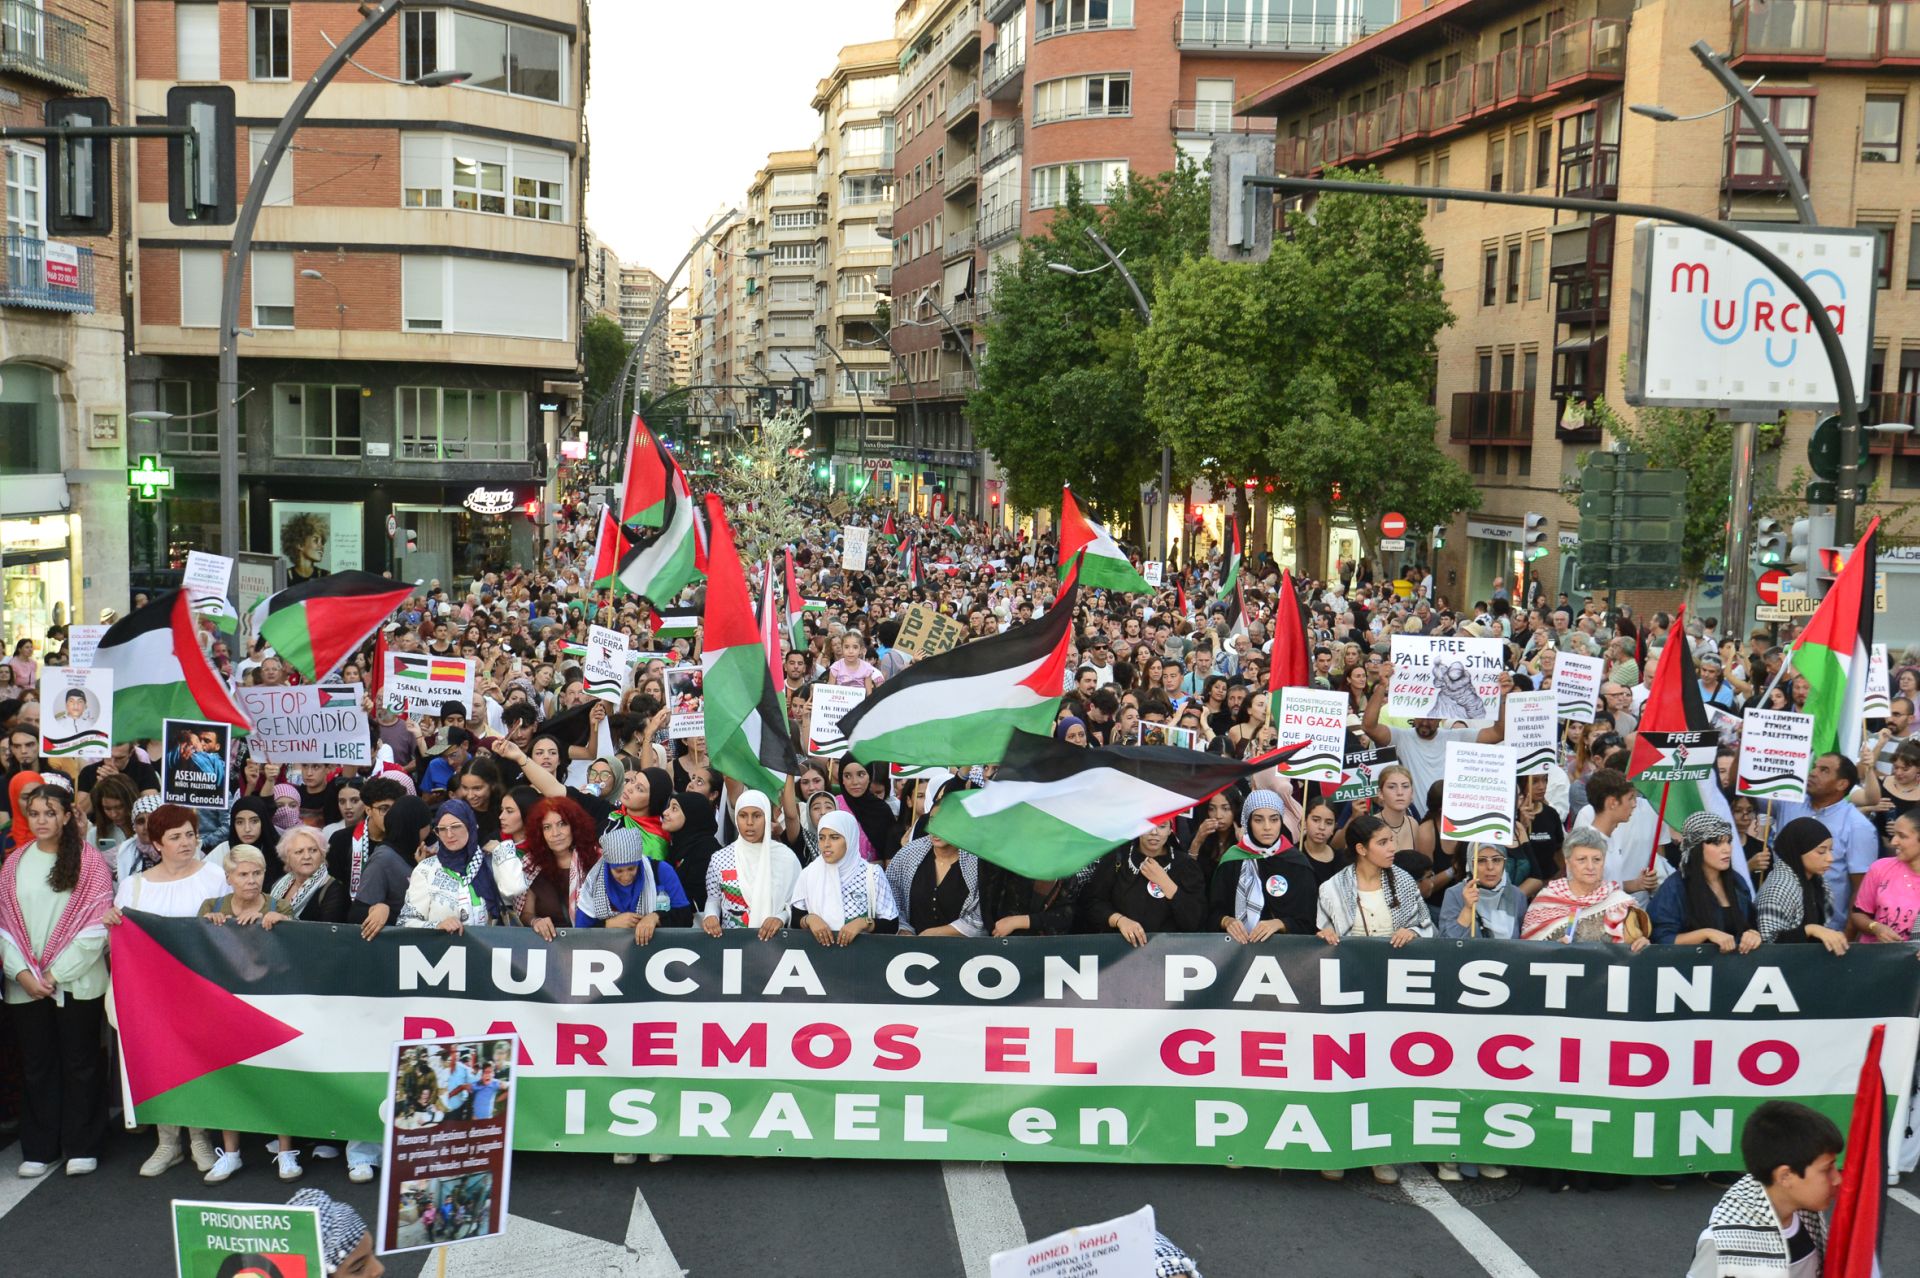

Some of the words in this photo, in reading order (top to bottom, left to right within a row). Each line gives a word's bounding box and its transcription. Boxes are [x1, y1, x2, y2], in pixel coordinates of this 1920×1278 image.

[1780, 599, 1821, 612] EUROP
[898, 608, 924, 650] STOP
[592, 636, 624, 651] GUERRA
[1430, 640, 1465, 652] FREE
[586, 664, 622, 680] GENOCIDIO
[397, 683, 422, 693] ISRAEL
[245, 691, 307, 714] STOP
[390, 693, 429, 706] PALTINA
[1286, 704, 1342, 716] HOSPITALES
[1285, 714, 1302, 725] EN
[1306, 716, 1342, 728] GAZA
[1773, 715, 1810, 724] LIMPIEZA
[1305, 733, 1340, 743] PAGUEN
[1666, 732, 1702, 744] FREE
[1346, 751, 1378, 764] FREE
[1763, 748, 1806, 758] GENOCIDIO
[174, 770, 217, 782] ASESINATO
[1458, 774, 1498, 784] EXIGIMOS
[1641, 769, 1707, 781] PALESTINE
[166, 791, 186, 802] Israel
[190, 793, 224, 804] Genocida
[1335, 786, 1379, 800] PALEST
[399, 944, 828, 997] MURCIA
[886, 952, 1099, 1000] CON
[1164, 954, 1800, 1014] PALESTINA
[985, 1026, 1098, 1075] EL
[1159, 1028, 1800, 1088] GENOCIDIO
[564, 1088, 948, 1143] ISRAEL
[1007, 1106, 1128, 1145] en
[1195, 1099, 1734, 1159] PALESTIN
[201, 1212, 291, 1230] PRISIONERAS
[207, 1235, 289, 1253] PALESTINAS
[1028, 1244, 1069, 1266] AHMED
[1079, 1232, 1117, 1250] KAHLA
[1030, 1257, 1078, 1276] ASESINADO
[1092, 1244, 1120, 1258] ENERO
